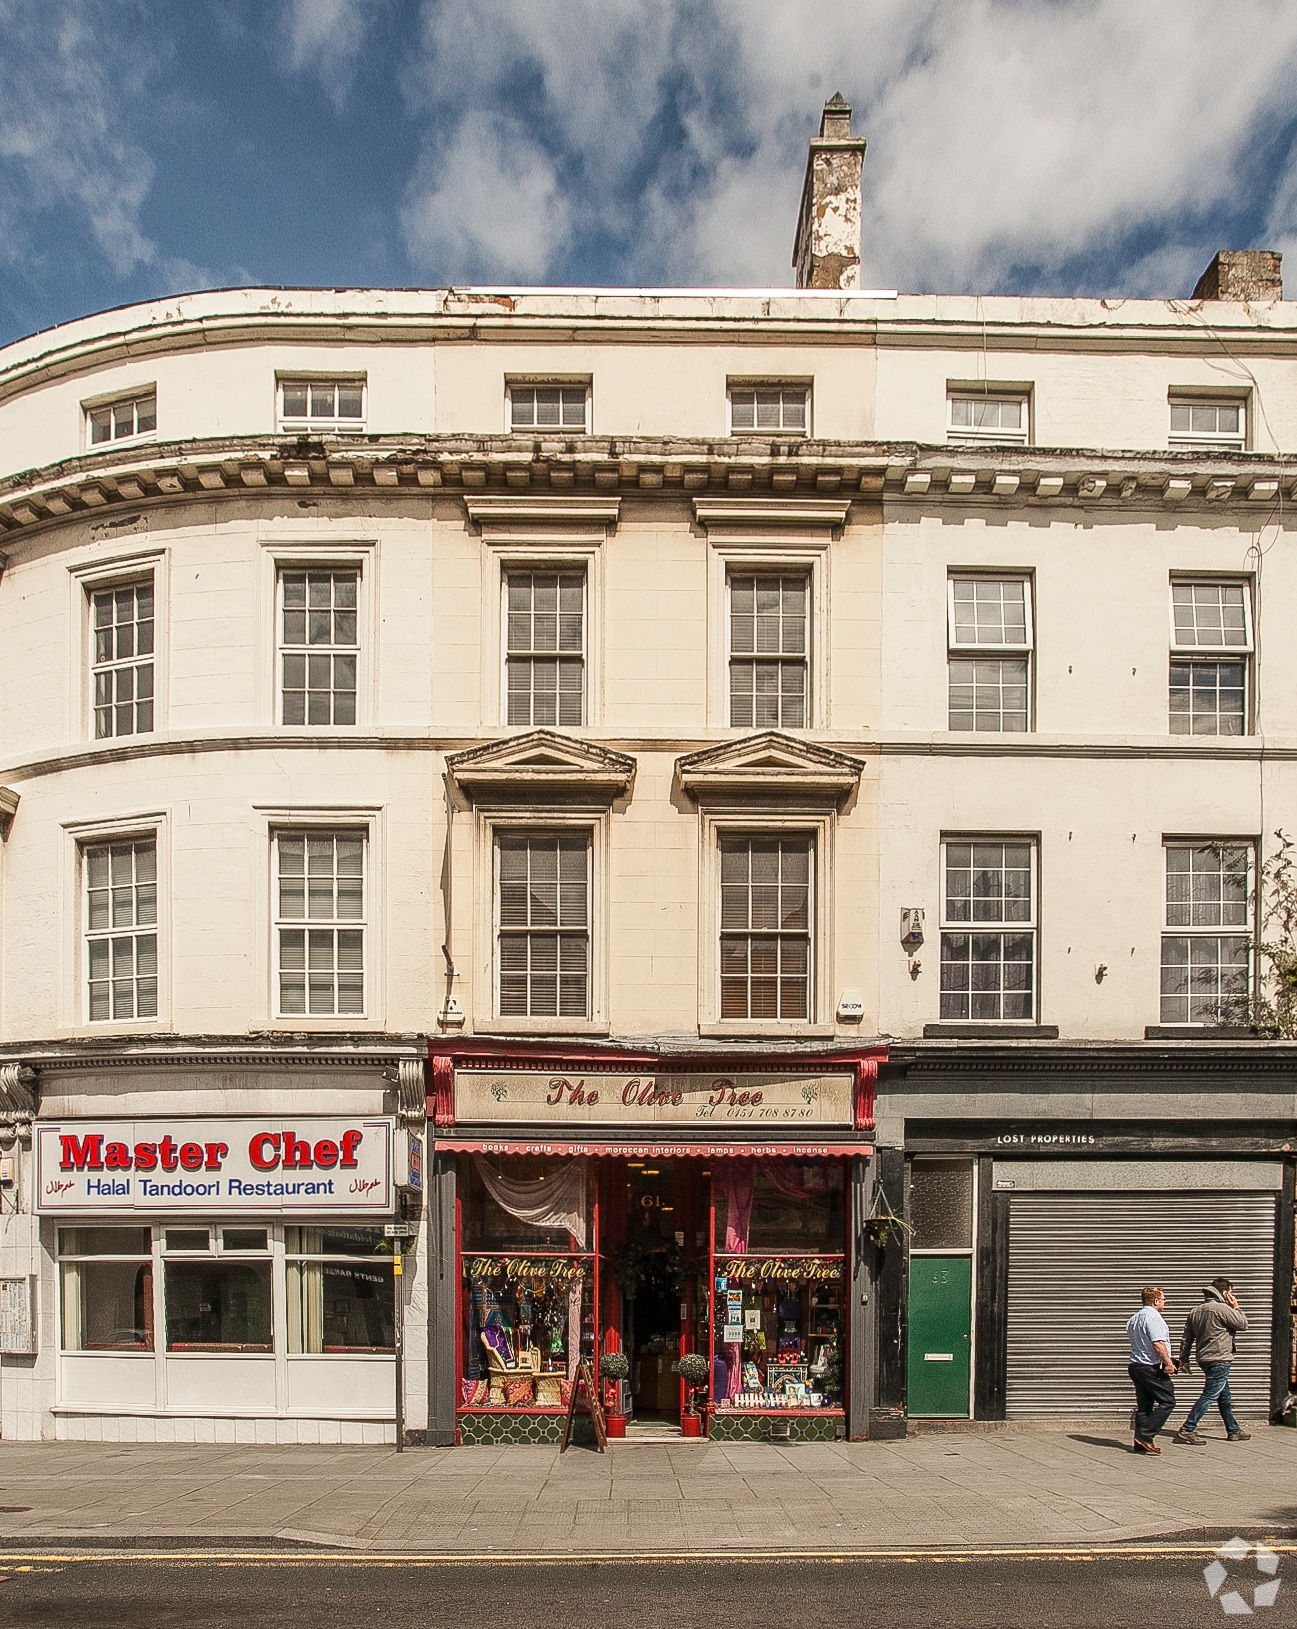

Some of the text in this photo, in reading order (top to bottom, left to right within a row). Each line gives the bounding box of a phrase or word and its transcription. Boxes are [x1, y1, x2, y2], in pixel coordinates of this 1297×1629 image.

[546, 1076, 764, 1106] The Olive Tree
[695, 1105, 716, 1118] Tel
[758, 1108, 780, 1118] 708
[997, 1134, 1096, 1145] LOST PROPERTIES
[58, 1134, 229, 1171] Master
[249, 1130, 364, 1171] Chef
[482, 1143, 829, 1155] books crafts gifts moroccan interiors lamps herbs incense
[86, 1178, 335, 1196] Halal Tandoori Restaurant
[470, 1257, 586, 1277] The Olive Tree
[723, 1259, 838, 1278] The Olive Tree
